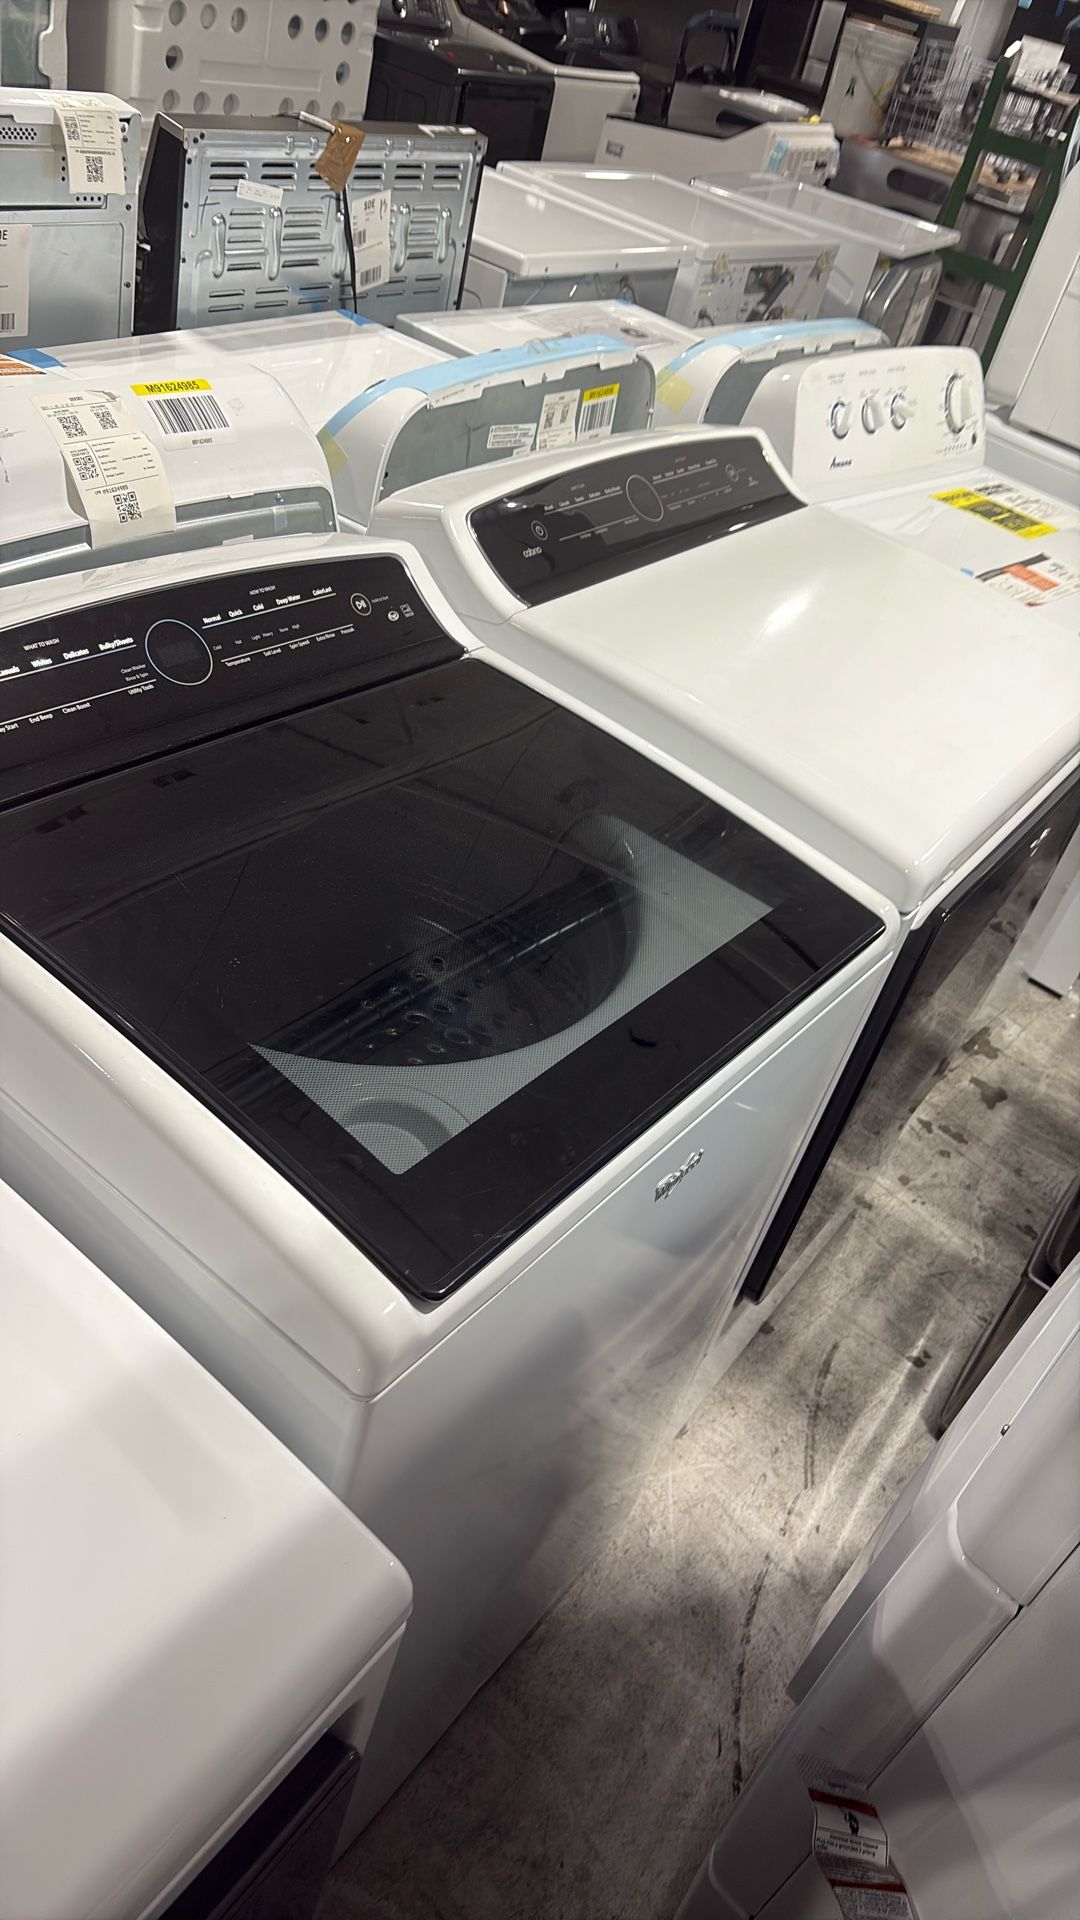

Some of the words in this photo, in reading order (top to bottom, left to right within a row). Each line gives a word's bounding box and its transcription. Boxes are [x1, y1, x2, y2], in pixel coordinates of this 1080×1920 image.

[144, 380, 200, 393] M91624985
[275, 598, 288, 606] Deep
[286, 594, 301, 602] Water
[252, 602, 265, 612] Cold
[228, 608, 243, 618] Quick
[202, 613, 222, 625] Normal
[23, 643, 38, 651] WHAT
[45, 638, 60, 646] WASH
[98, 637, 134, 651] Bulky/Sheets
[62, 648, 90, 660] Delicates
[30, 658, 53, 668] Whites
[224, 657, 251, 667] Temperature
[127, 687, 143, 695] Utility
[62, 706, 77, 714] Clean
[76, 702, 91, 710] Boost
[28, 716, 40, 724] End
[39, 713, 54, 721] Beep
[5, 723, 20, 731] Start
